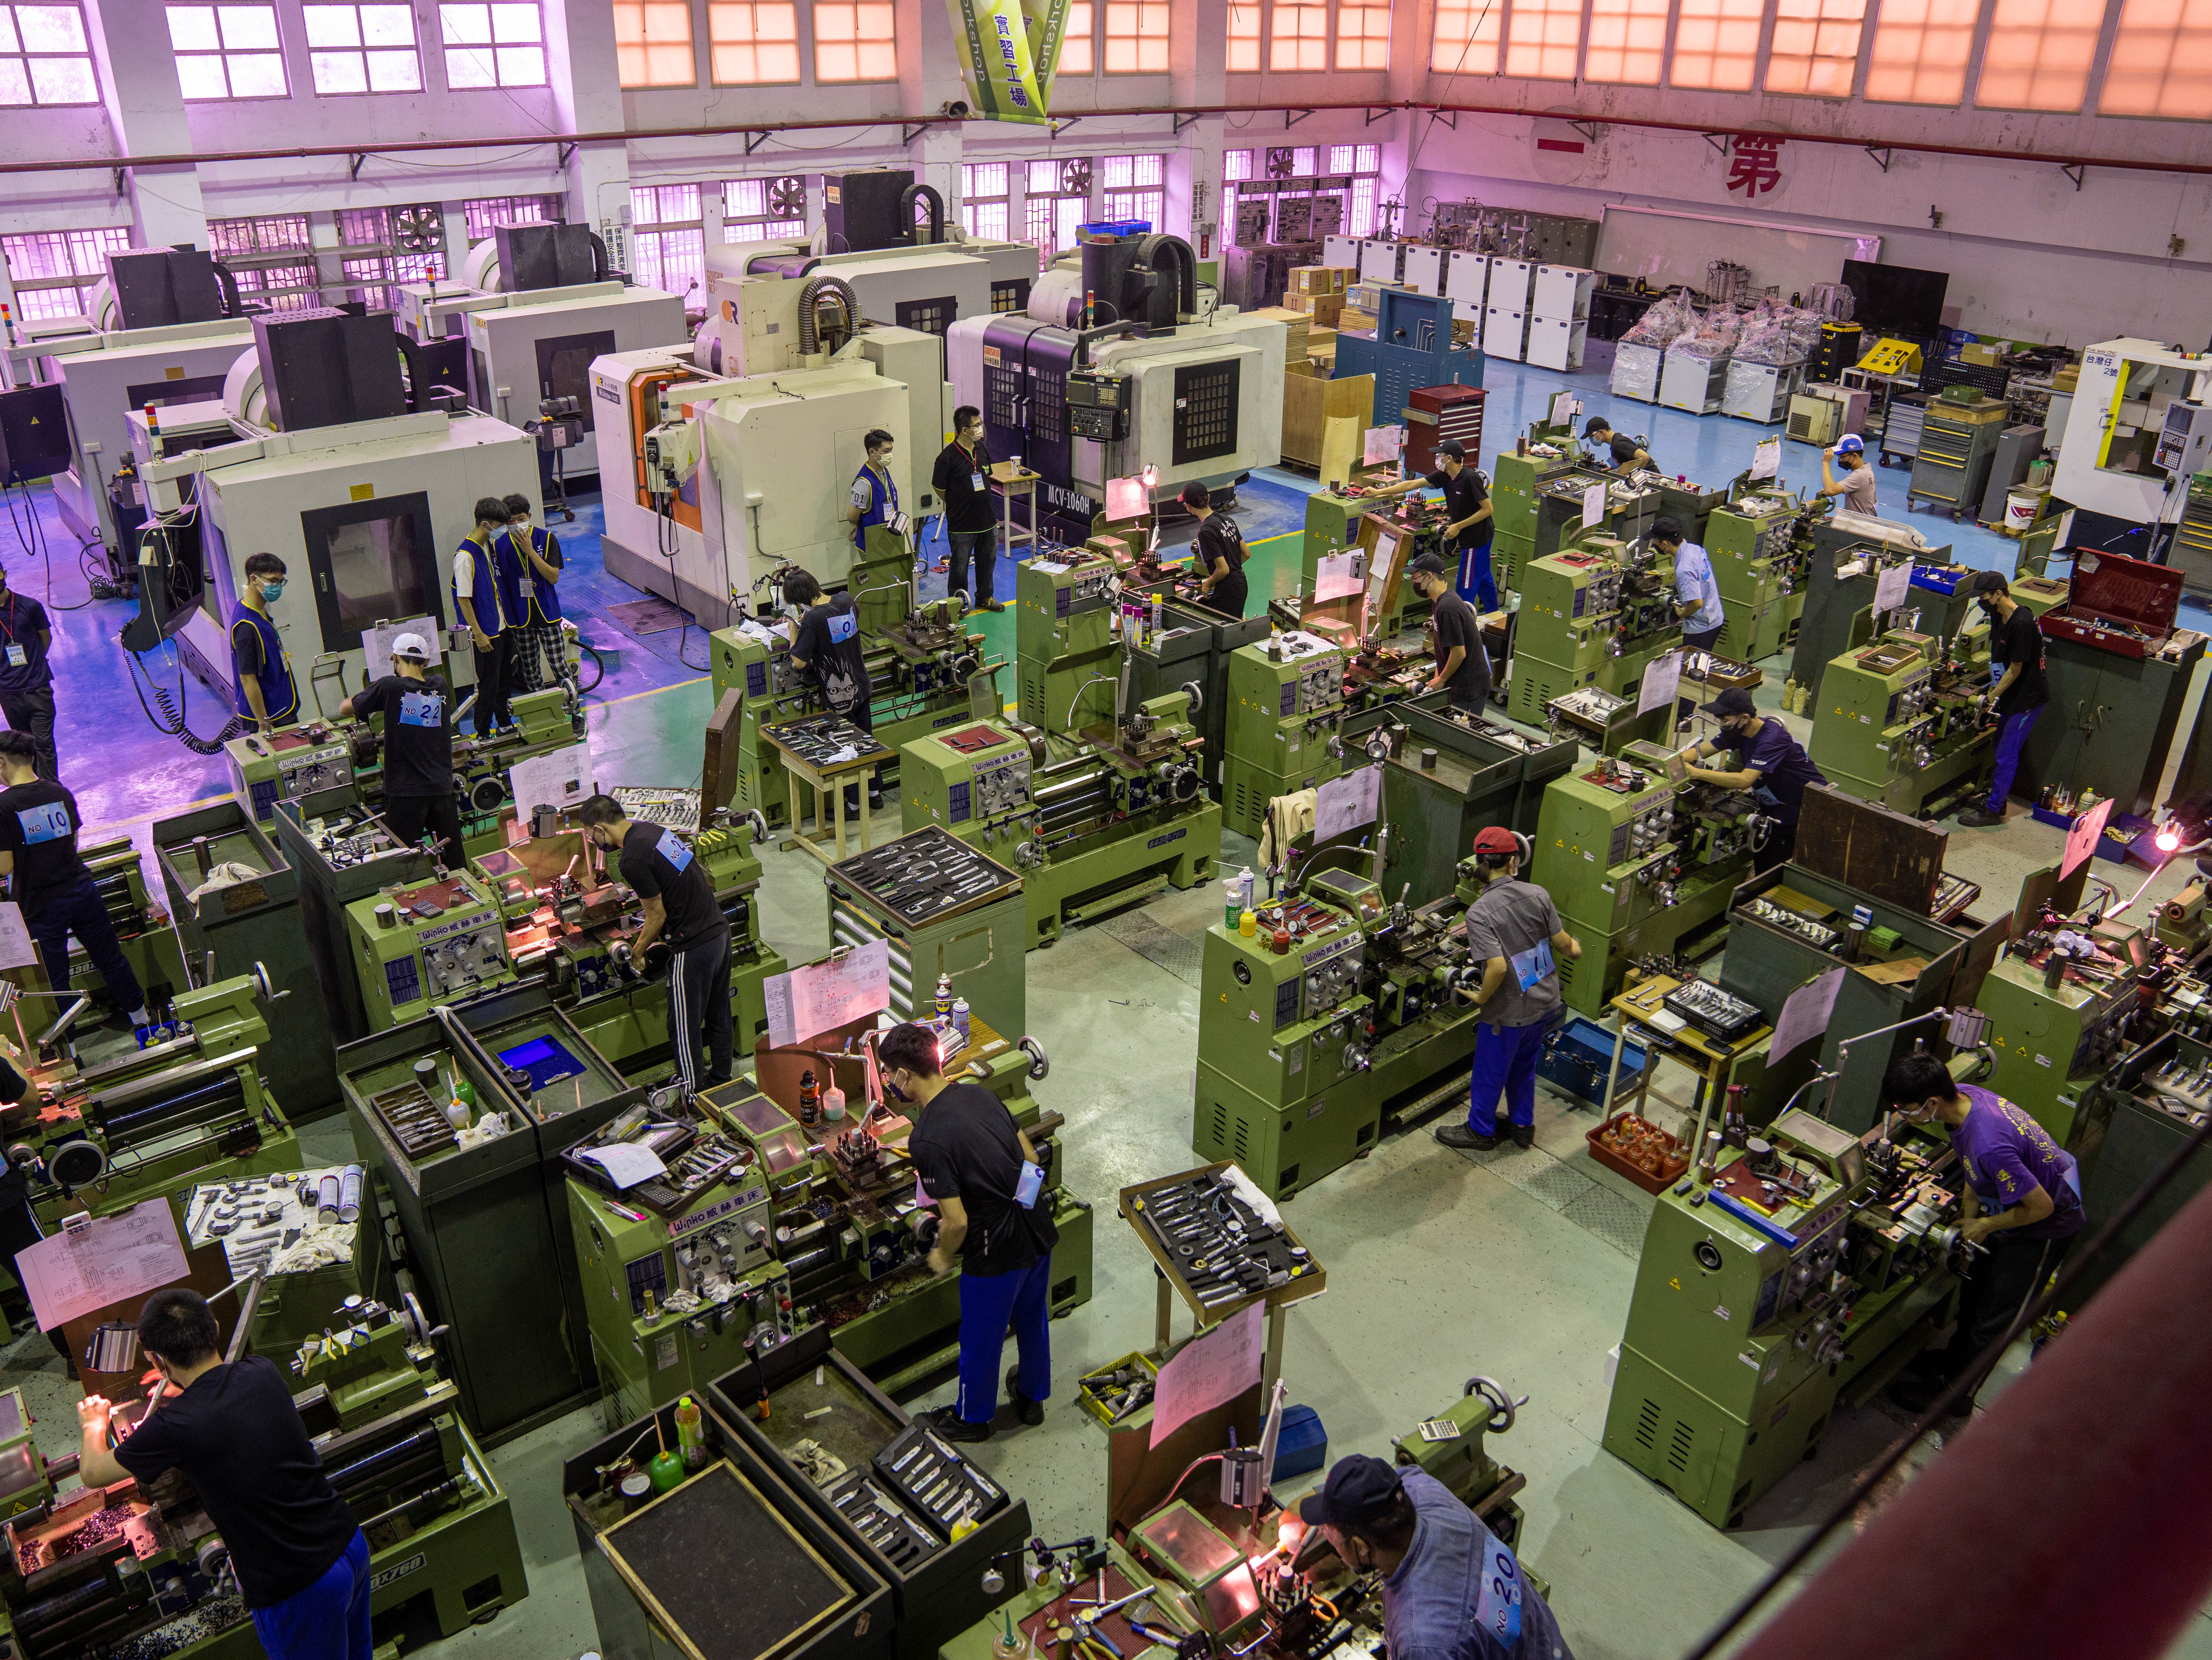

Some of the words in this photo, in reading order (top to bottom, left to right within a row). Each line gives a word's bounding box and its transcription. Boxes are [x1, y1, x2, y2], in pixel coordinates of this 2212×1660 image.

[994, 15, 1028, 108] 實習工場
[1727, 133, 1785, 198] 第
[614, 228, 626, 271] 保持整齊清潔
[984, 346, 1000, 357] GOUSHIN
[2087, 355, 2112, 366] 台灣仔
[2104, 368, 2118, 377] 2號
[854, 493, 865, 503] 01
[1048, 485, 1089, 515] MCV-1060H
[419, 704, 439, 719] 22
[995, 751, 1025, 765] 威赫車床
[28, 824, 42, 834] NO
[47, 811, 66, 830] 10
[670, 850, 680, 862] NO
[450, 912, 493, 931] 威赫車床
[1326, 934, 1359, 954] 威赫車床
[1518, 968, 1526, 979] NO
[1534, 951, 1547, 972] 11
[706, 1189, 759, 1219] 威赫車床
[1493, 1552, 1514, 1606] 20
[1496, 1609, 1507, 1635] NO
